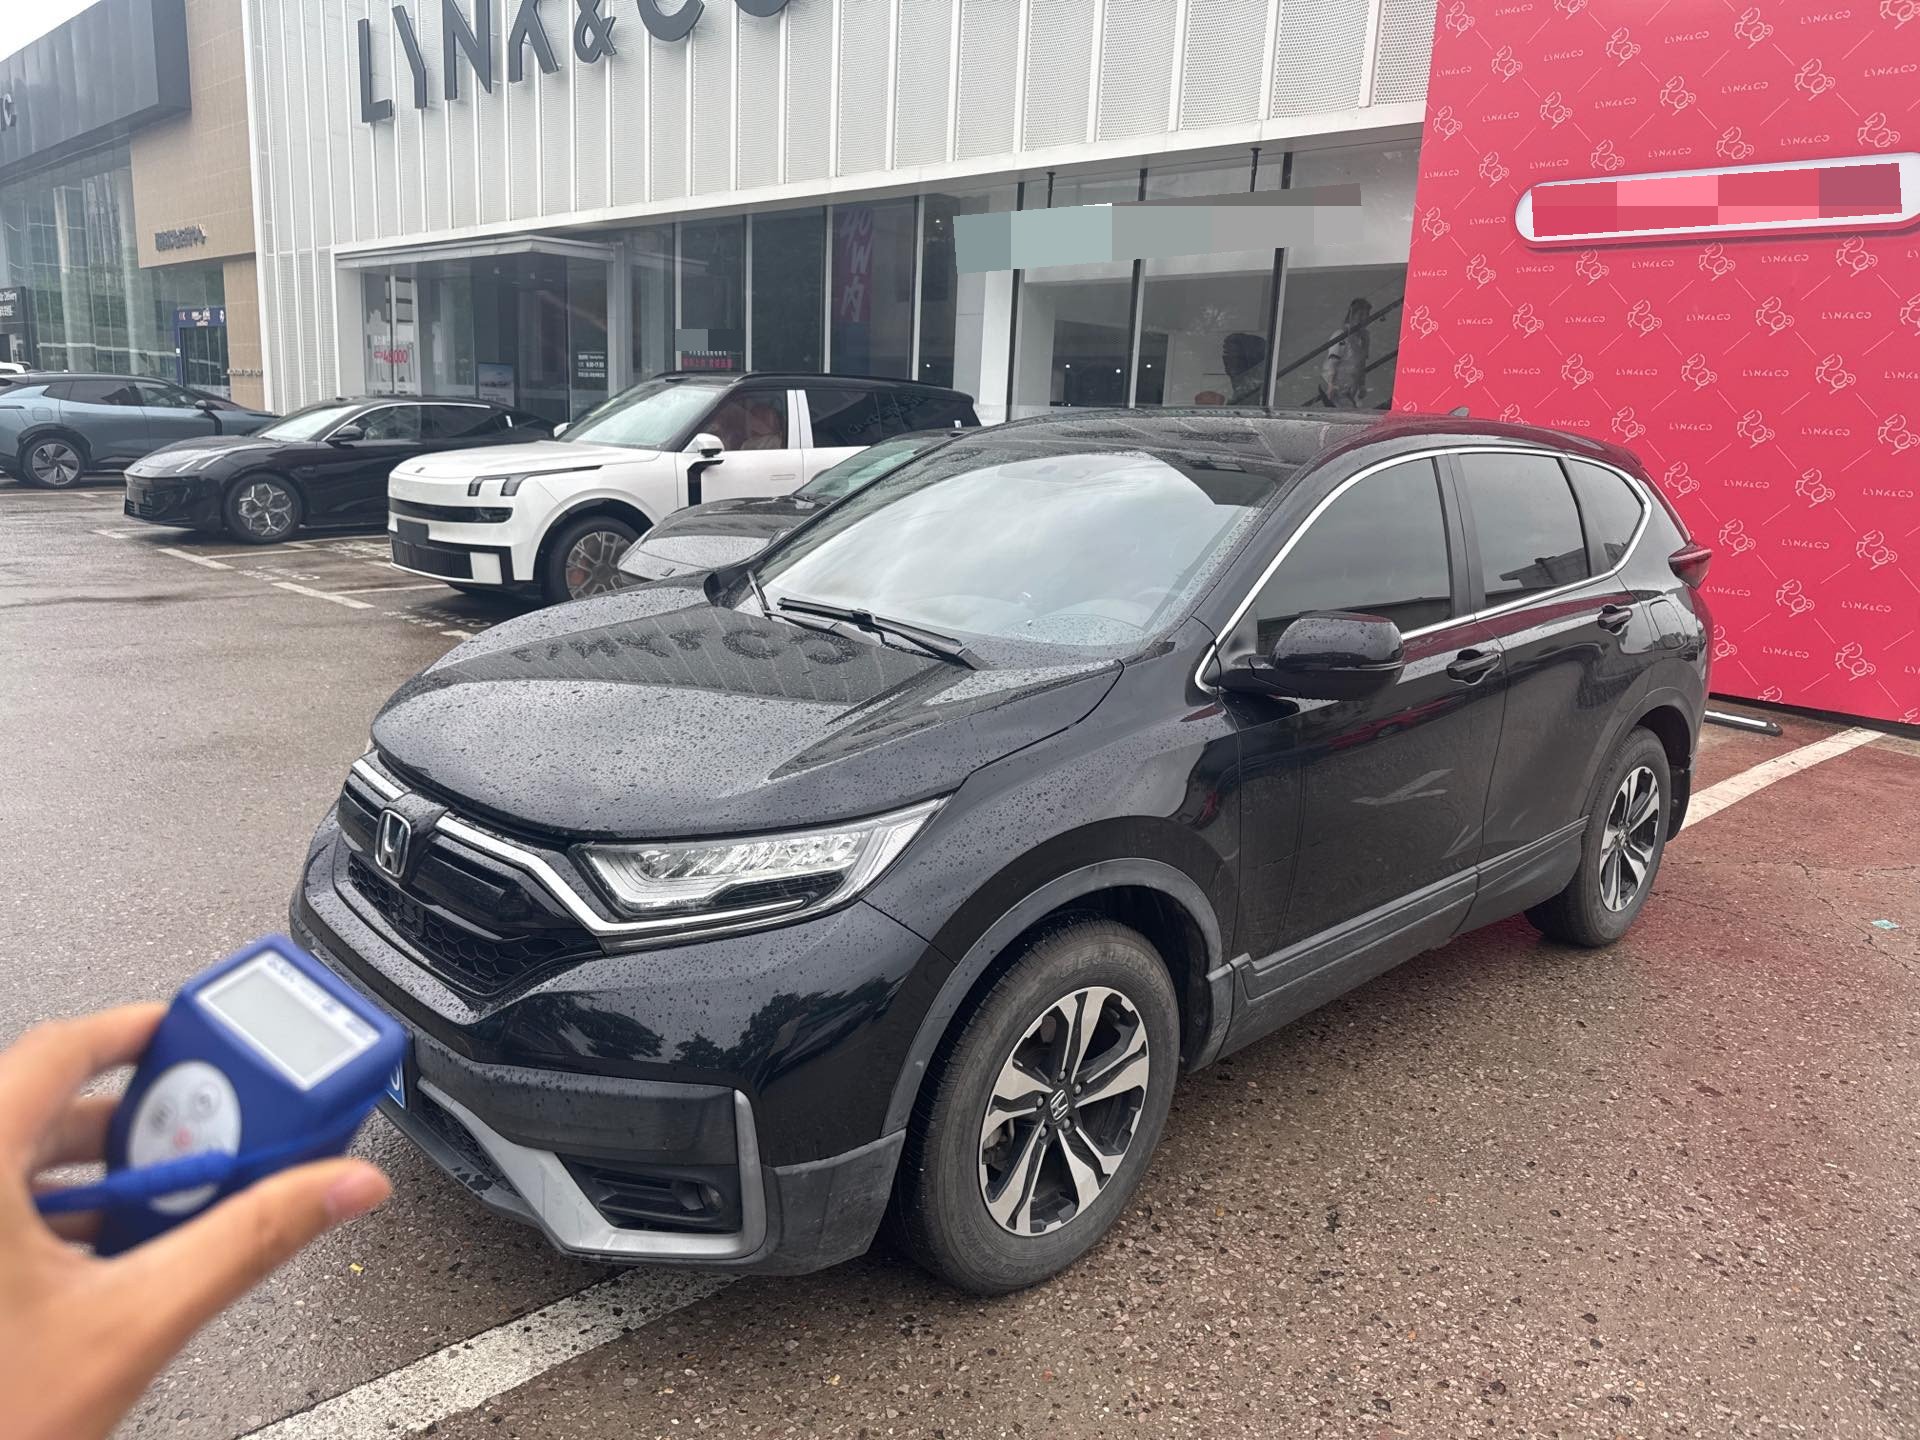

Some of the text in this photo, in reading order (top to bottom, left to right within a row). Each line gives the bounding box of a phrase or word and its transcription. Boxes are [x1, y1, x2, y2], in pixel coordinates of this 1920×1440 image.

[1496, 4, 1533, 16] LYNK&CO
[1801, 10, 1851, 24] LYNK&CO
[1665, 31, 1709, 43] LYNK&CO
[1544, 49, 1583, 61] LYNK&CO
[358, 0, 791, 123] LYNK&
[1437, 66, 1471, 77] LYNK&CO
[1864, 64, 1918, 77] LYNK&CO
[1722, 82, 1768, 93] LYNK&CO
[1595, 97, 1636, 109] LYNK&CO
[1482, 112, 1519, 122] LYNK&CO
[1781, 135, 1830, 146] LYNK&CO
[1648, 147, 1691, 160] LYNK&CO
[1530, 159, 1569, 169] LYNK&CO
[1424, 168, 1459, 178] LYNK&CO
[1470, 216, 1506, 225] LYNK&CO
[1632, 260, 1674, 268] LYNK&CO
[1762, 254, 1809, 264] LYNK&CO
[1413, 269, 1447, 277] LYNK&CO
[1517, 265, 1554, 273] LYNK&CO
[1565, 316, 1605, 325] LYNK&CO
[1687, 313, 1730, 321] LYNK&CO
[1616, 368, 1657, 376] LYNK&CO
[1743, 369, 1789, 377] LYNK&CO
[1884, 371, 1920, 379] LYNK&
[1551, 418, 1590, 428] LYNK&CO
[1669, 423, 1712, 432] LYNK&CO
[1802, 425, 1850, 436] LYNK&CO
[1724, 480, 1769, 488] LYNK&CO
[1863, 488, 1913, 498] LYNK&CO
[1782, 539, 1829, 549] LYNK&CO
[1706, 584, 1751, 597] LYNK&CO
[1842, 600, 1891, 612] LYNK&CO
[1763, 646, 1809, 660] LYNK&CO
